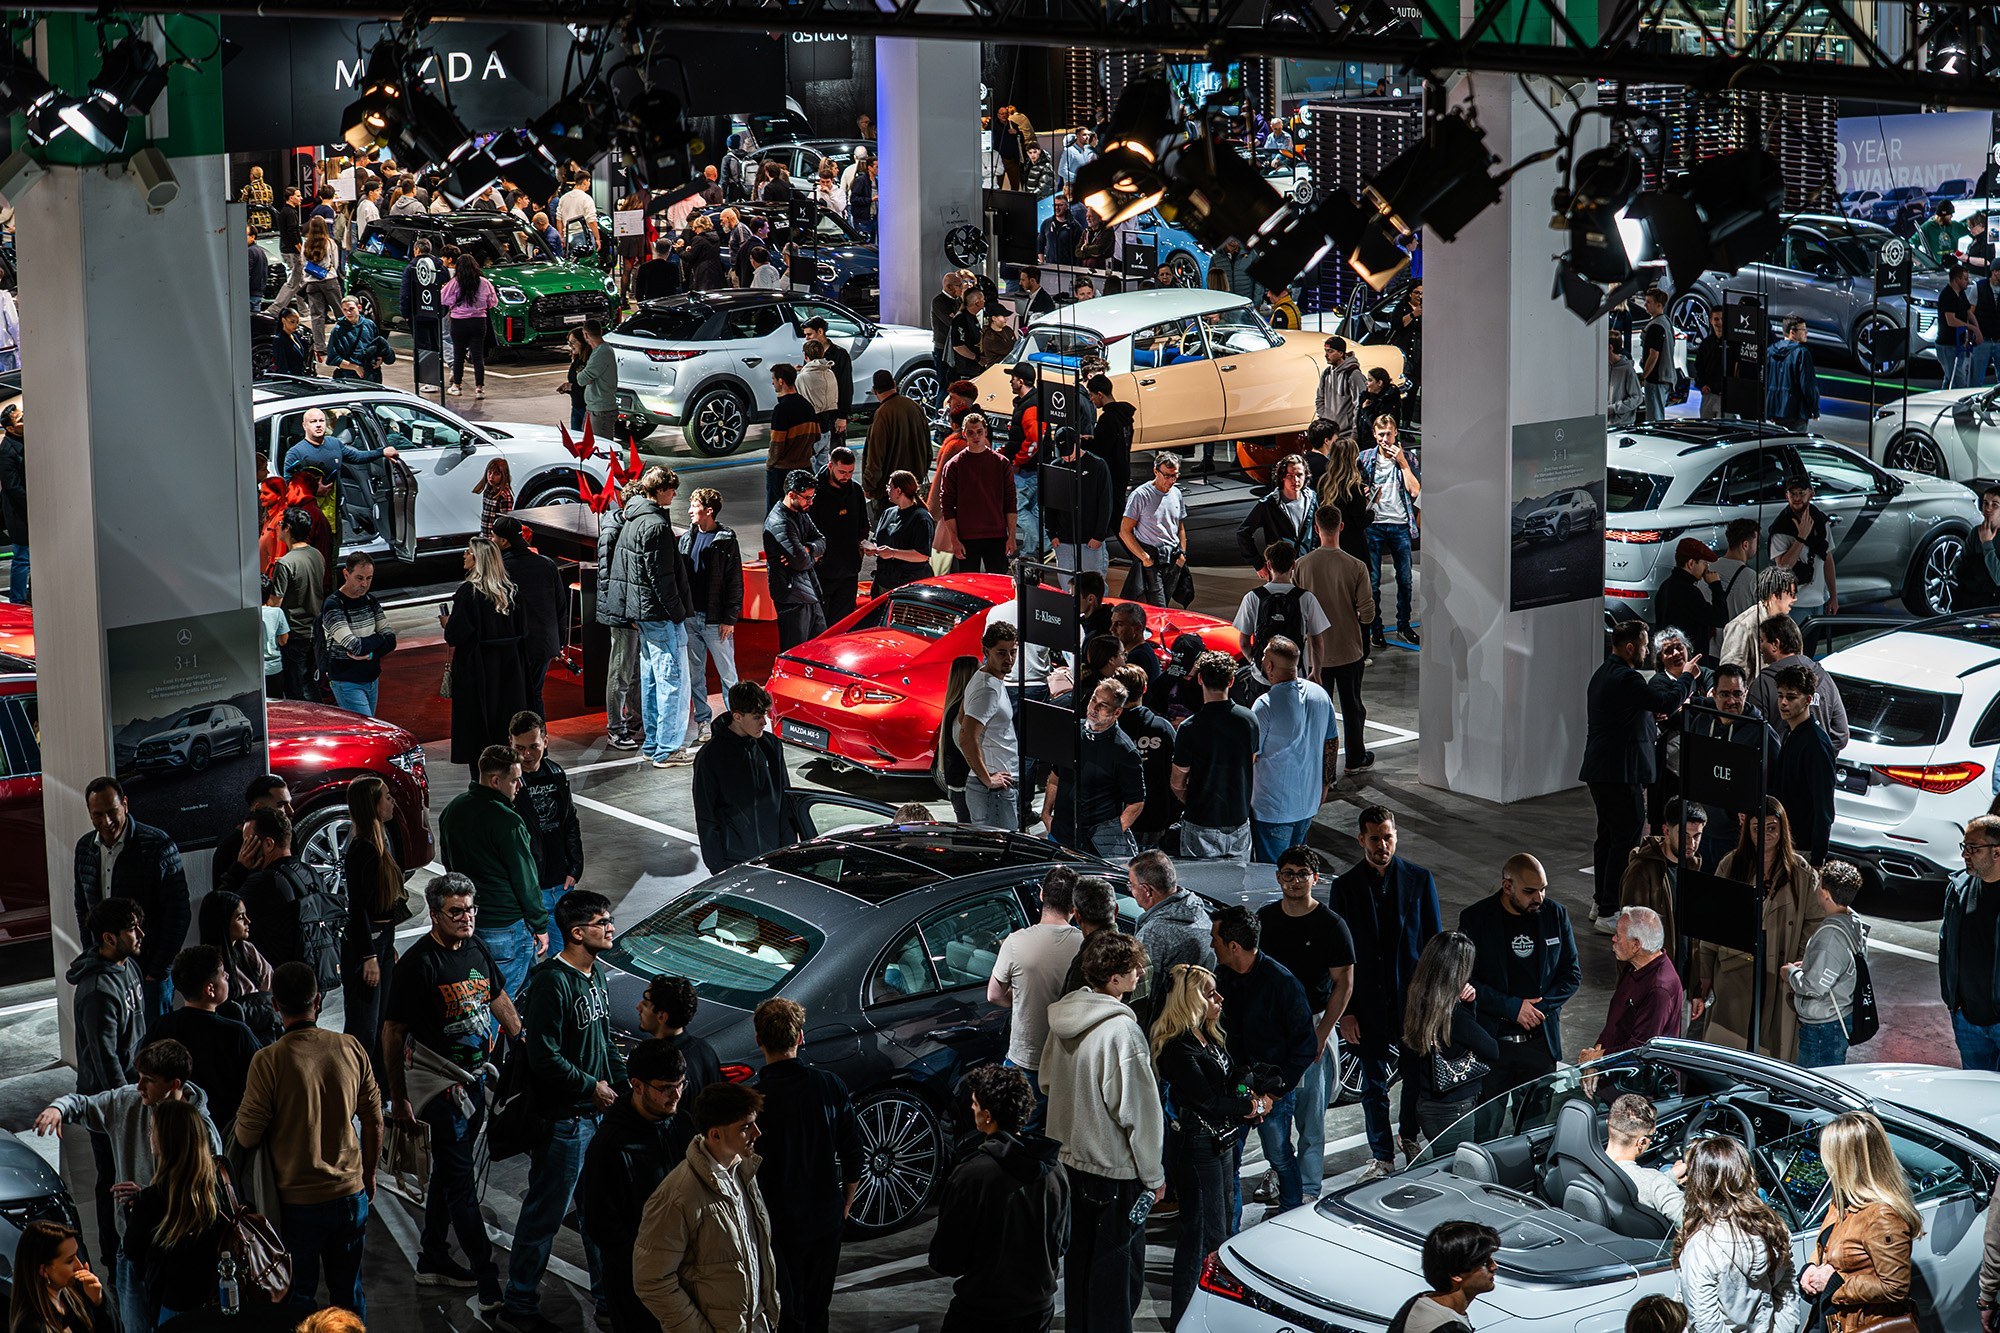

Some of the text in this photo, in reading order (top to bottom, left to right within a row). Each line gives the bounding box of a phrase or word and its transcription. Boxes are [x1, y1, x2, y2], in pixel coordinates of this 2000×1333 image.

[335, 50, 507, 91] MZDA
[1852, 138, 1902, 164] YEAR
[1852, 163, 1962, 193] WARRANTY
[1035, 609, 1062, 626] E-Klasse
[789, 725, 807, 736] MAZDA
[1713, 765, 1732, 781] CLE
